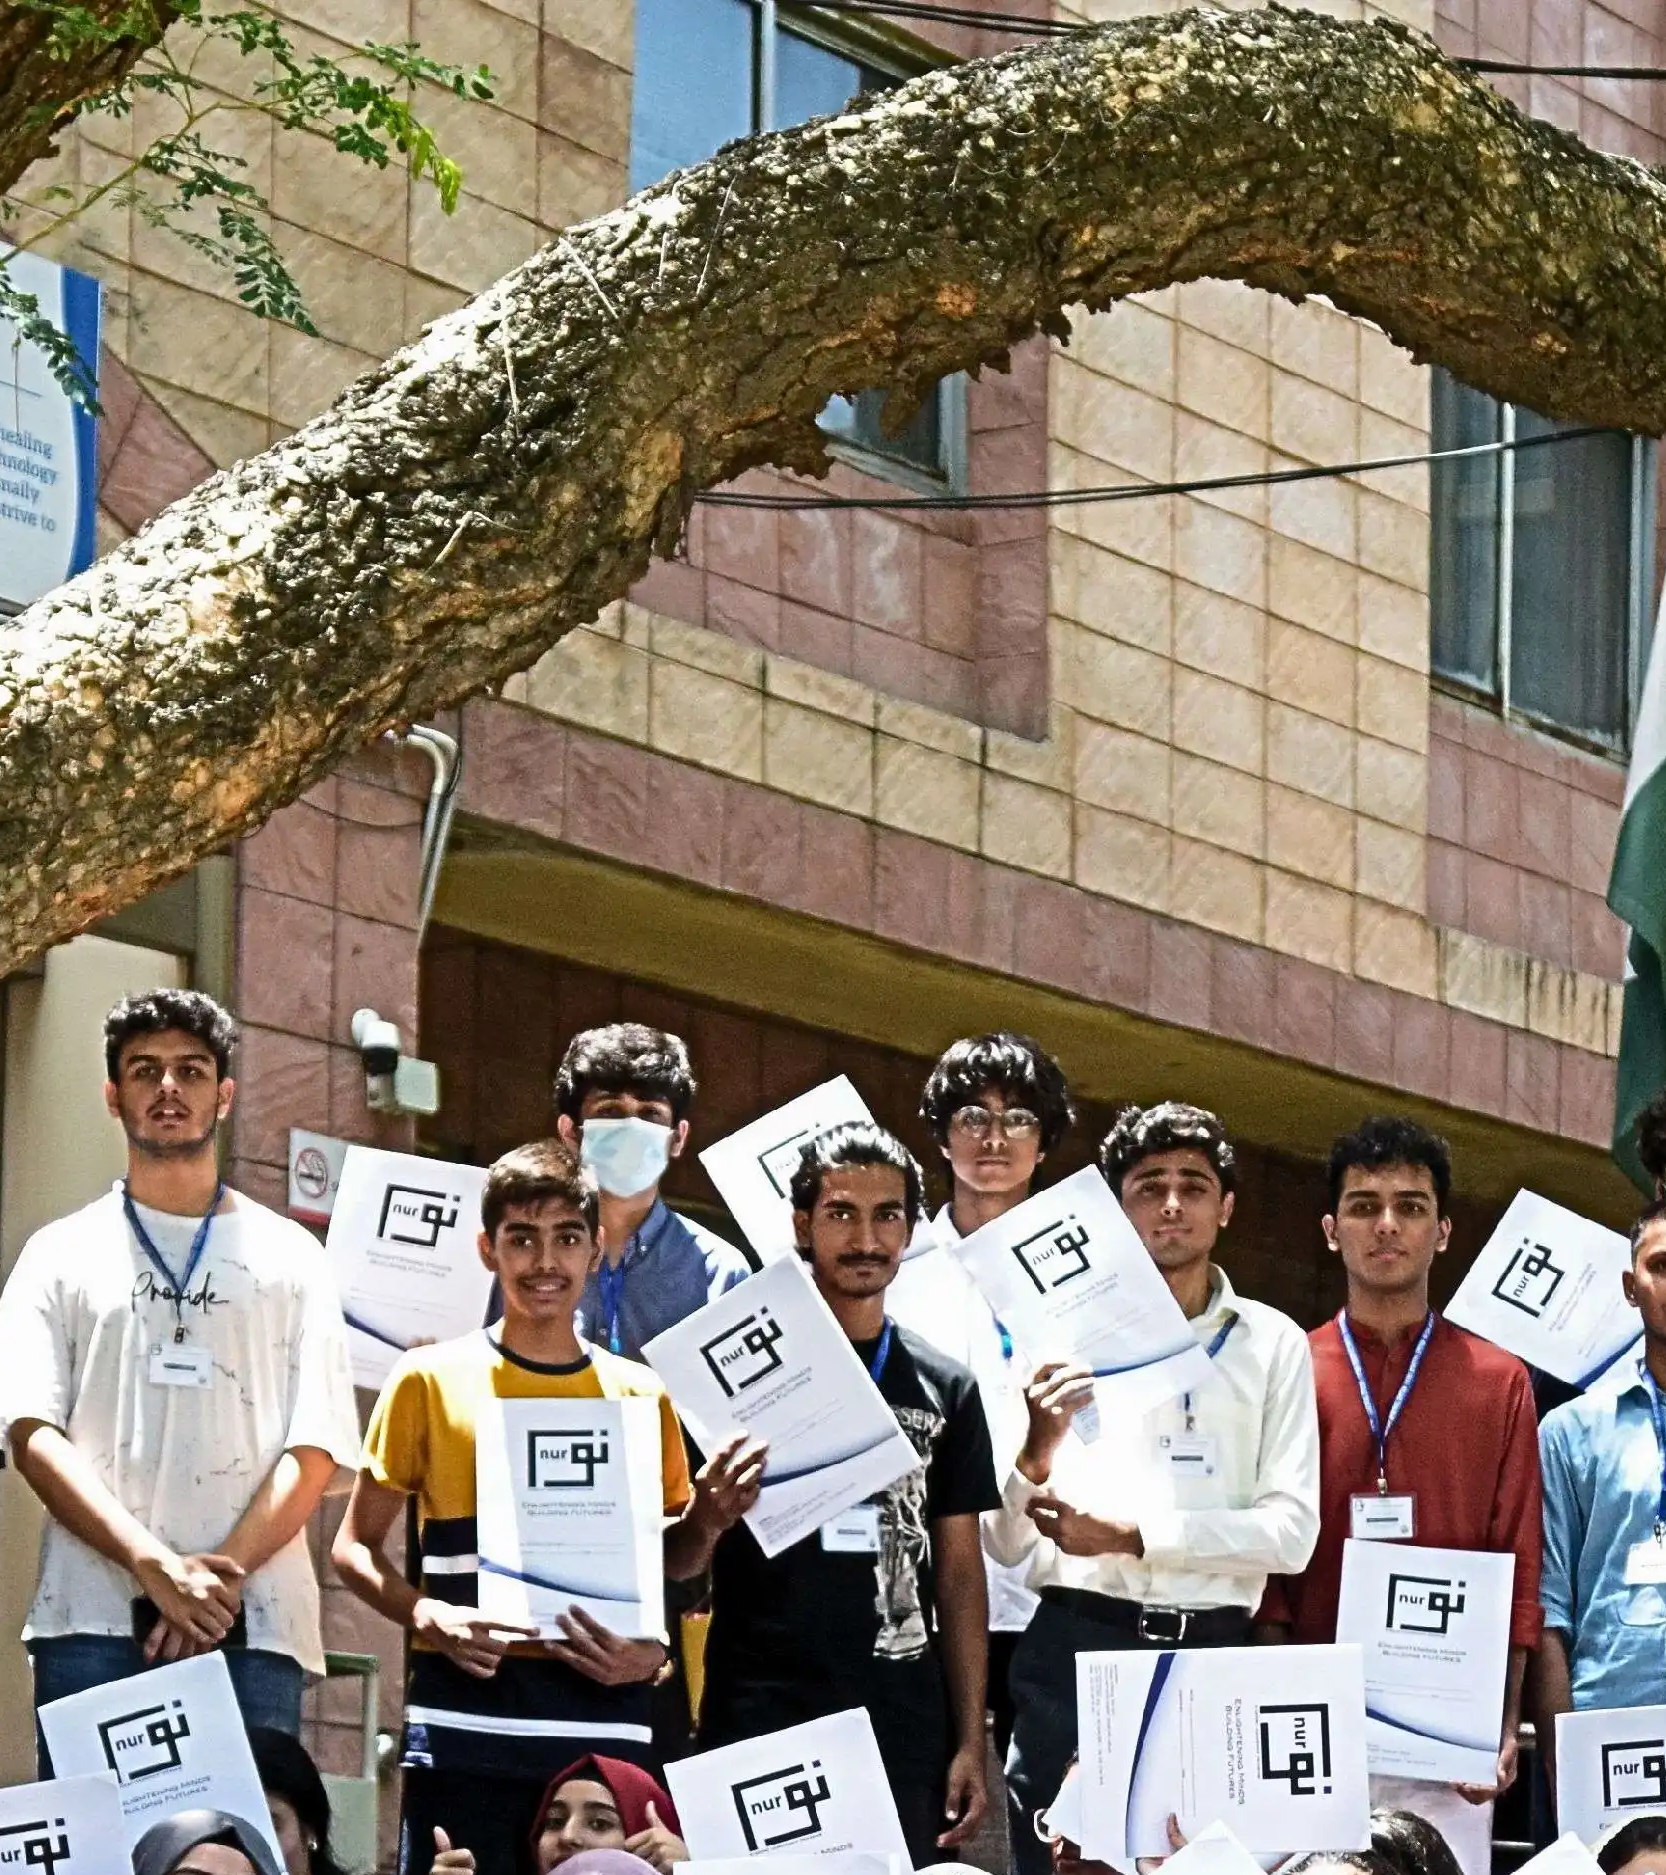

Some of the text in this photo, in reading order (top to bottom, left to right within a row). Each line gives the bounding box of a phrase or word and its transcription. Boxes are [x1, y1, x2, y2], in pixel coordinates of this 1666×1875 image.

[393, 1202, 420, 1217] nur
[719, 1344, 746, 1367] nur
[540, 1448, 569, 1460] nur
[1399, 1592, 1425, 1605] nur
[1294, 1718, 1306, 1748] nur
[115, 1733, 145, 1752] nur
[1613, 1761, 1639, 1777] nur
[751, 1794, 782, 1816] nur
